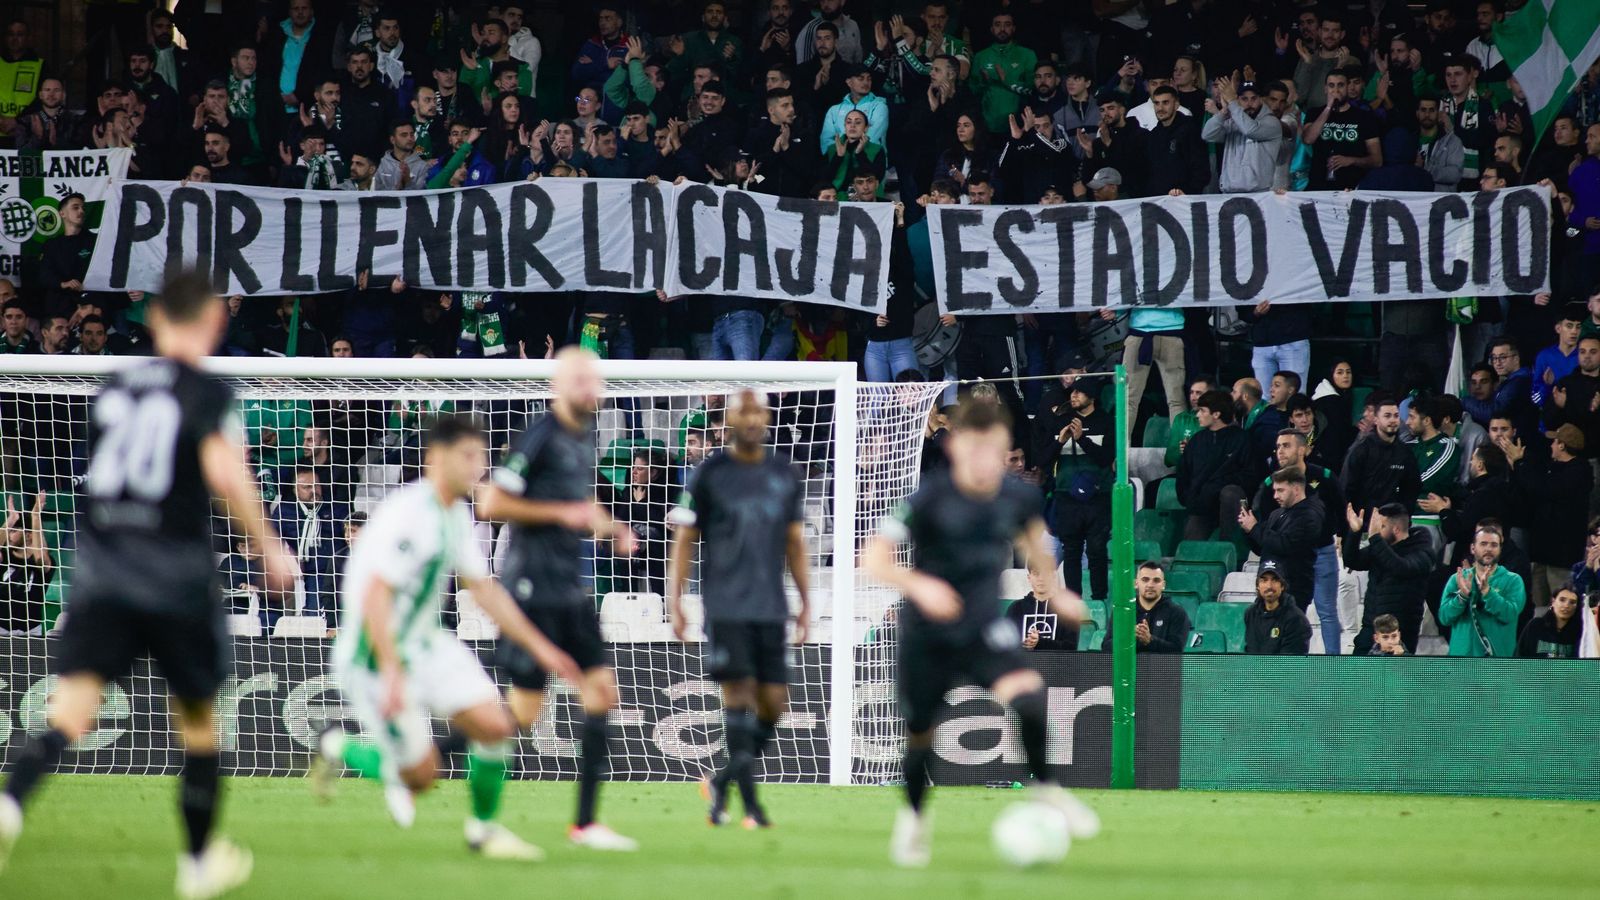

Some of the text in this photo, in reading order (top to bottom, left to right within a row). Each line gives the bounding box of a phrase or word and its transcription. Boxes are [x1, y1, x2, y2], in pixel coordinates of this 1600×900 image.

[109, 181, 882, 307] POR LLENAR LA CAJA
[940, 196, 1269, 312] ESTADIO
